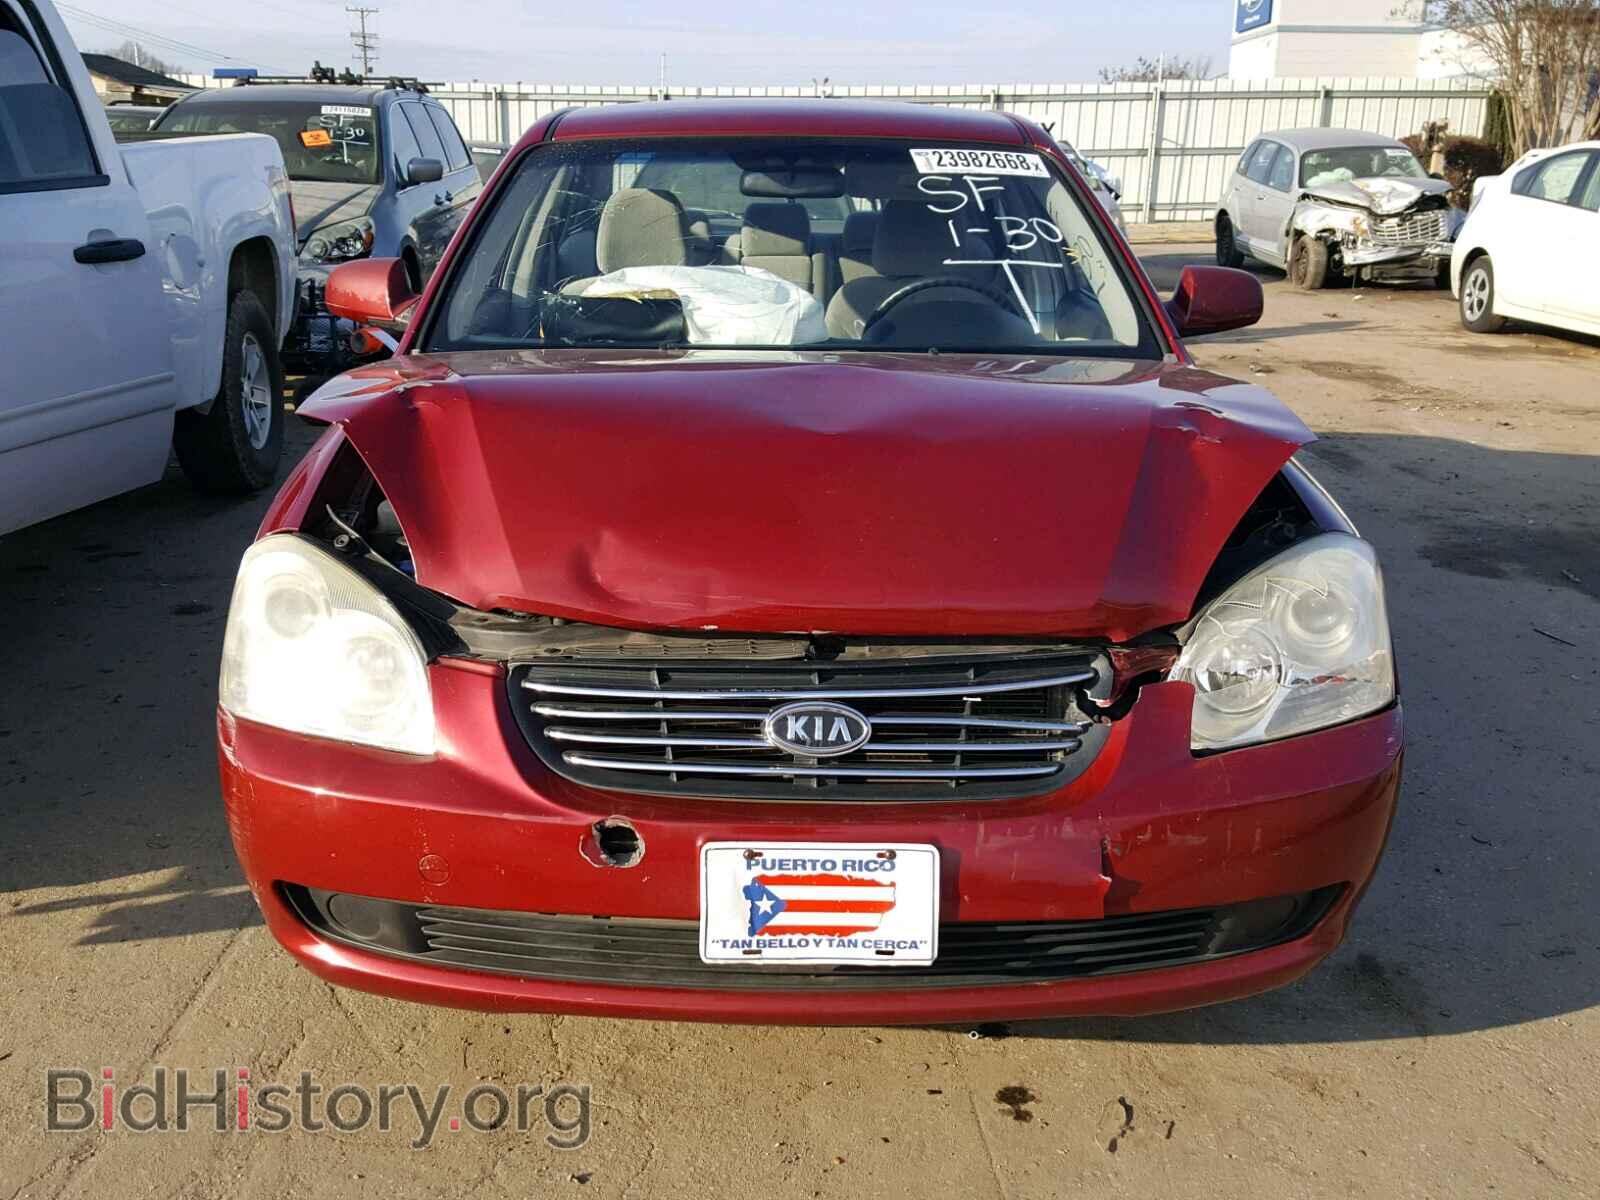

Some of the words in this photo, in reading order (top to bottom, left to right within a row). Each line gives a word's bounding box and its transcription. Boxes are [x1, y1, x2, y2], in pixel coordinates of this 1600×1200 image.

[329, 127, 365, 140] 1-30
[932, 150, 1031, 171] 23982668
[917, 175, 1006, 213] SF
[948, 216, 1063, 250] 1-30
[786, 714, 853, 743] KIA
[746, 857, 837, 872] PUERTO
[842, 857, 896, 872] RICO
[756, 937, 809, 949] BELLO
[812, 937, 823, 949] Y
[825, 937, 859, 949] TAN
